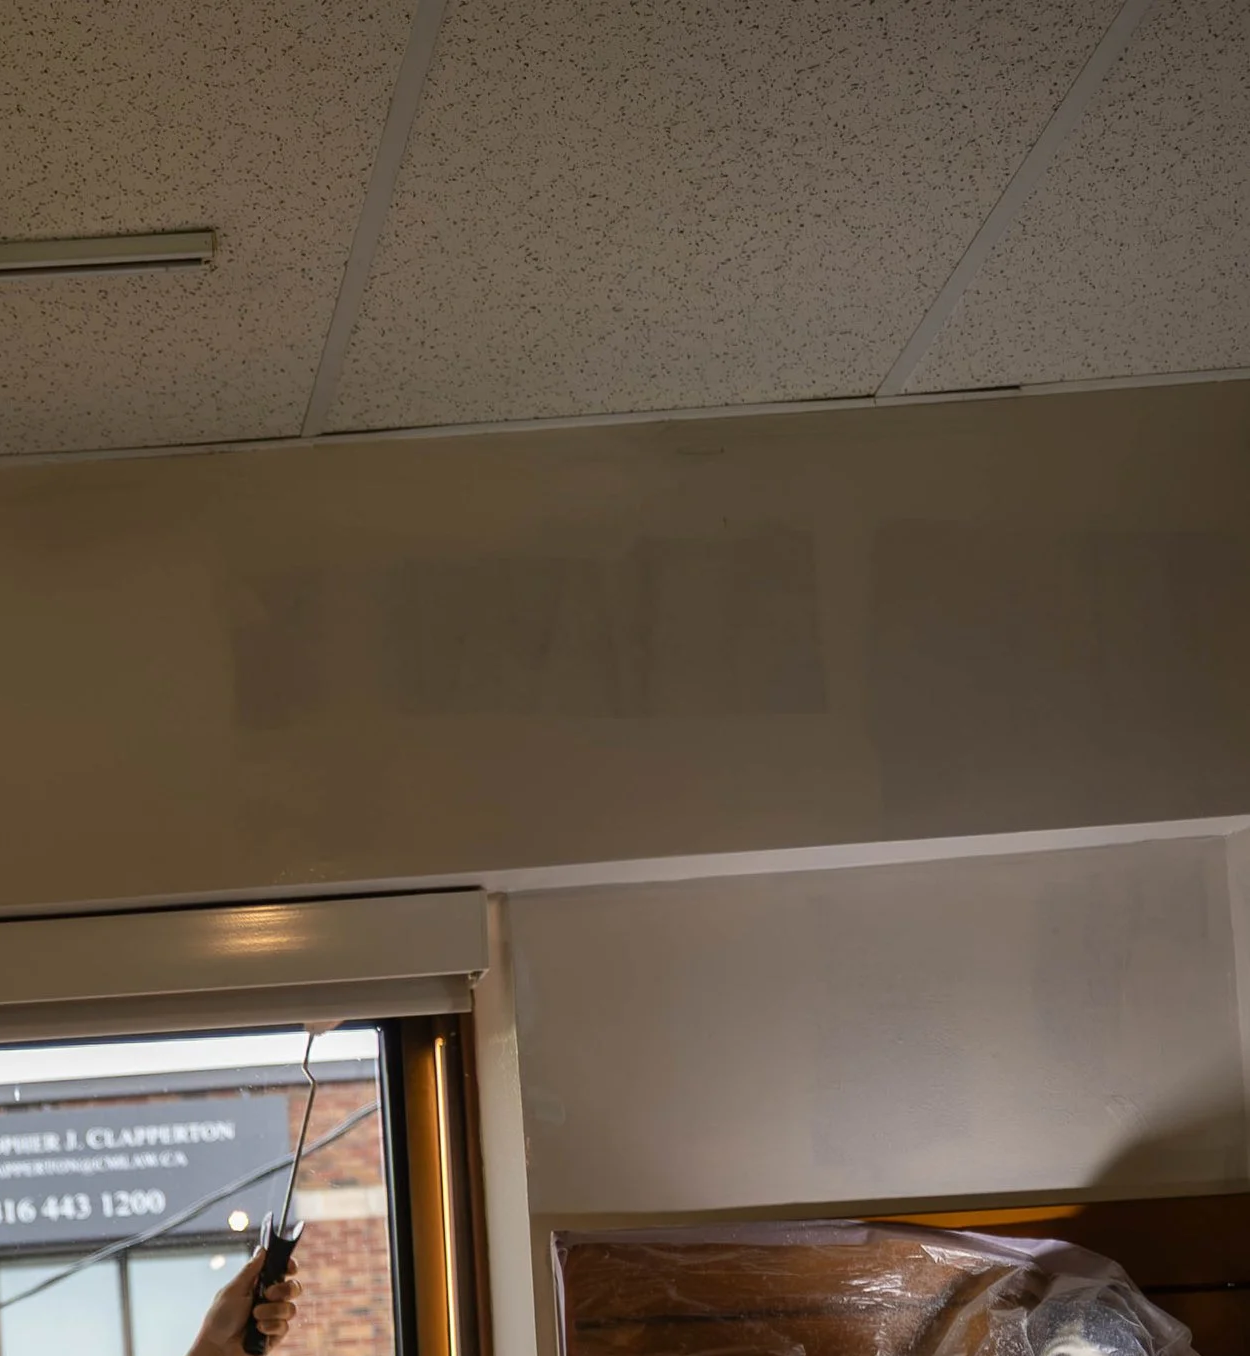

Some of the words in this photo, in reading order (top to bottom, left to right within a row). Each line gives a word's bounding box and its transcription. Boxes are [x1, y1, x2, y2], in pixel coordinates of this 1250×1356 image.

[87, 1121, 235, 1149] CLAPPERTON
[41, 1193, 92, 1221] 443
[101, 1188, 166, 1218] 1200
